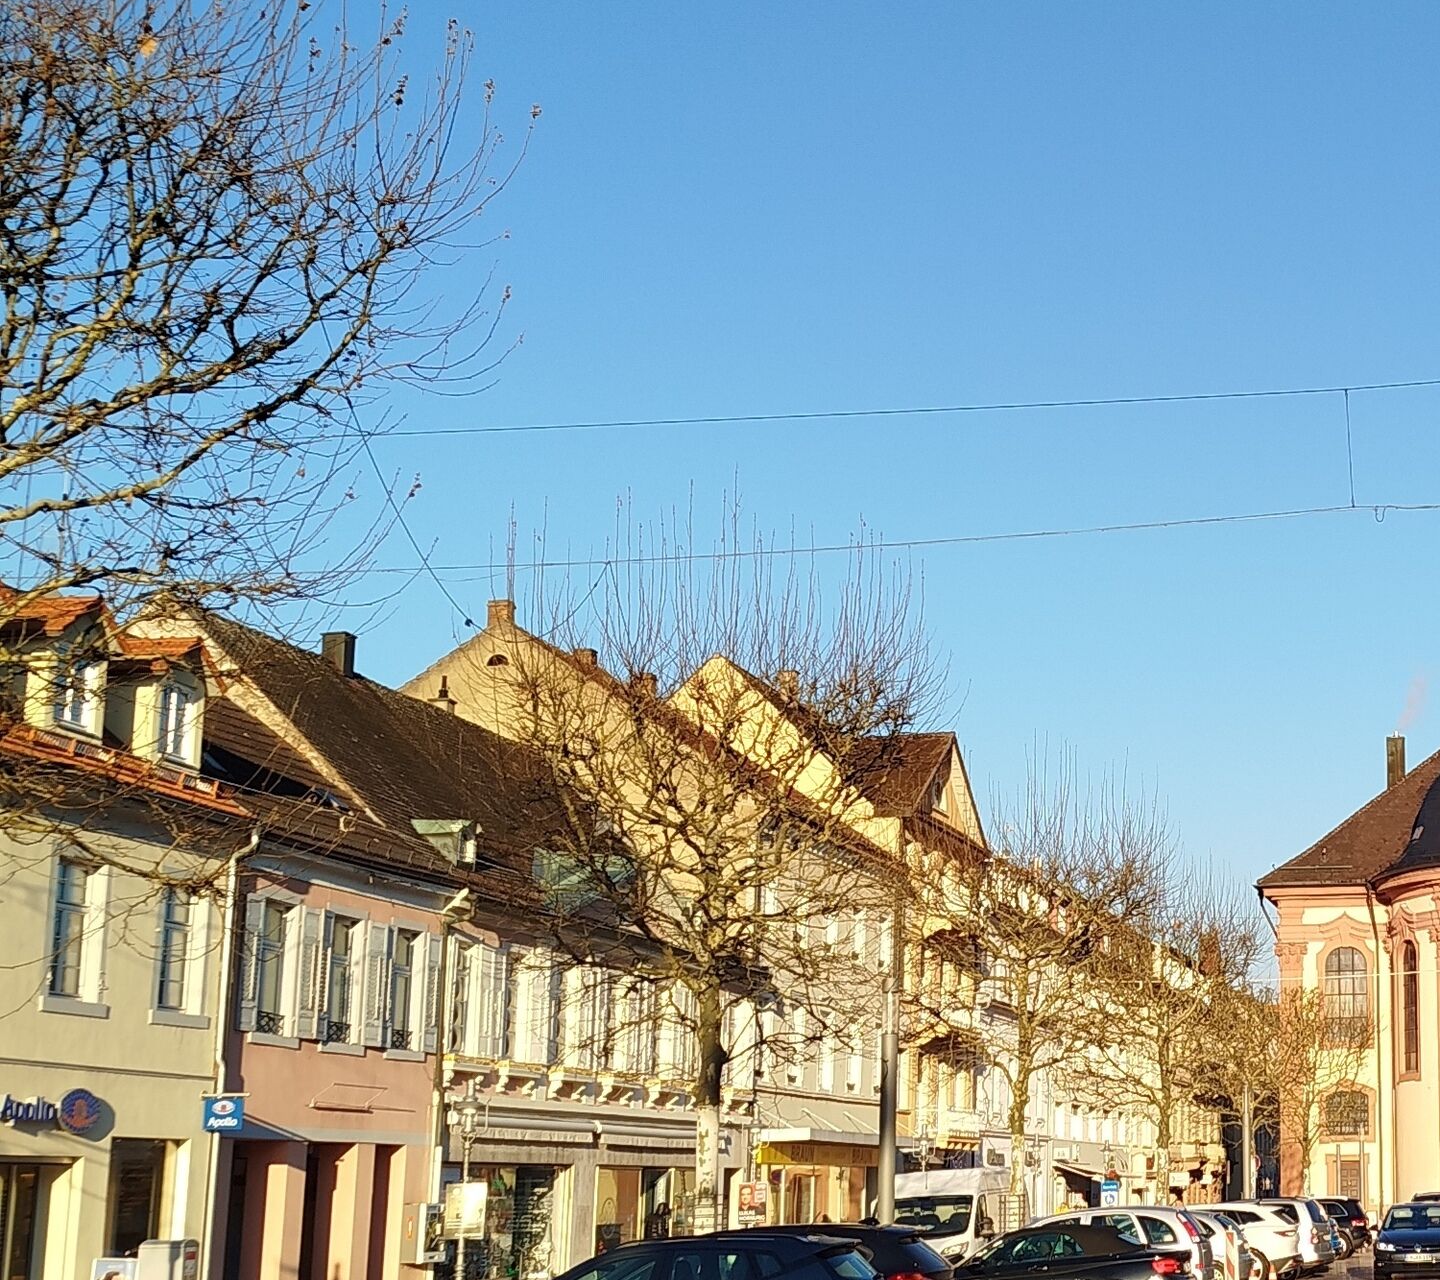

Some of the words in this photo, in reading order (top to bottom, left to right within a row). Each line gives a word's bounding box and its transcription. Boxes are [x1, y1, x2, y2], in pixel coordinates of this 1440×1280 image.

[1, 1094, 56, 1121] Apollo
[207, 1116, 238, 1128] Apollo
[790, 1145, 815, 1162] BRAUN
